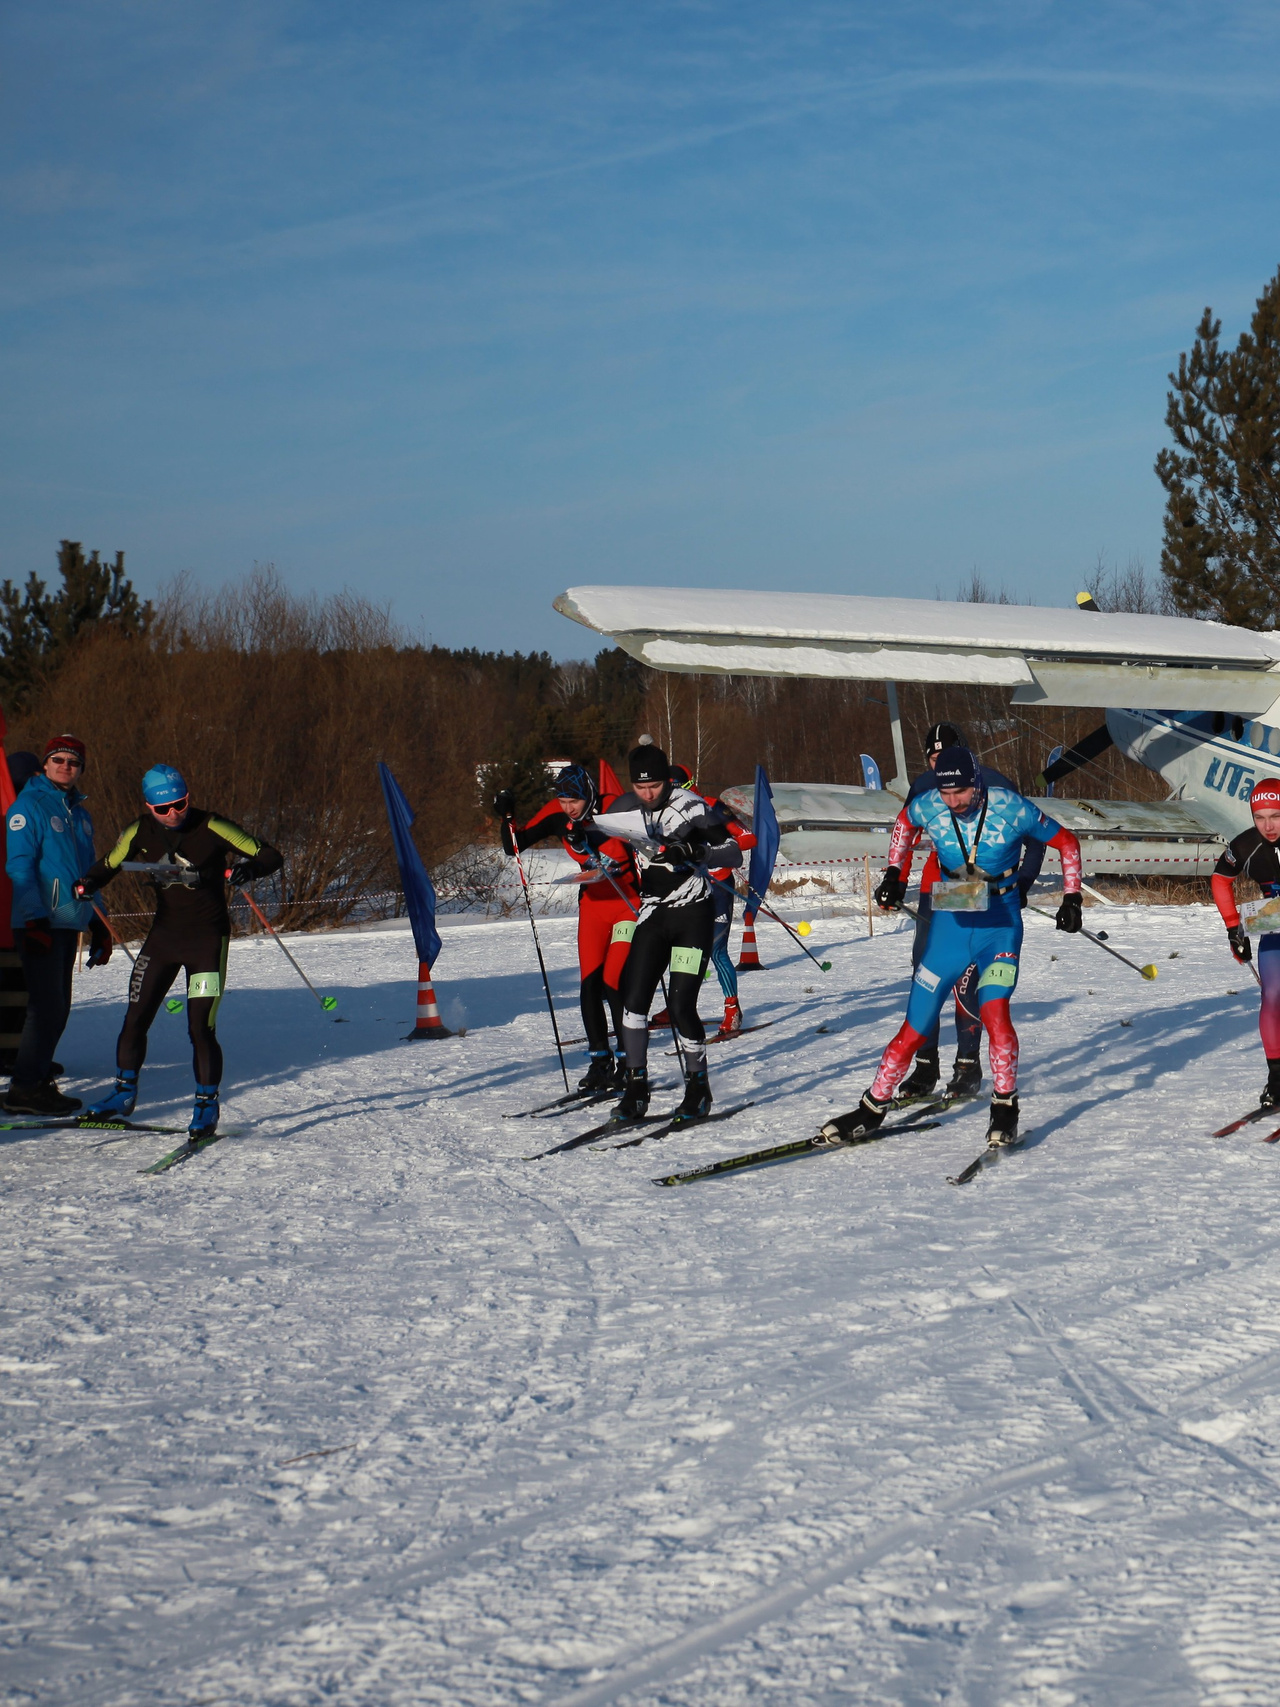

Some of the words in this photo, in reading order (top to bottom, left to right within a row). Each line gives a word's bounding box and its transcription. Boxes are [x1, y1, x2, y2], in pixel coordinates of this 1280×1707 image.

[616, 927, 628, 935] 6.1
[988, 969, 1004, 978] 3.1
[79, 1121, 126, 1131] BRADOS
[678, 1163, 715, 1179] FISCHER
